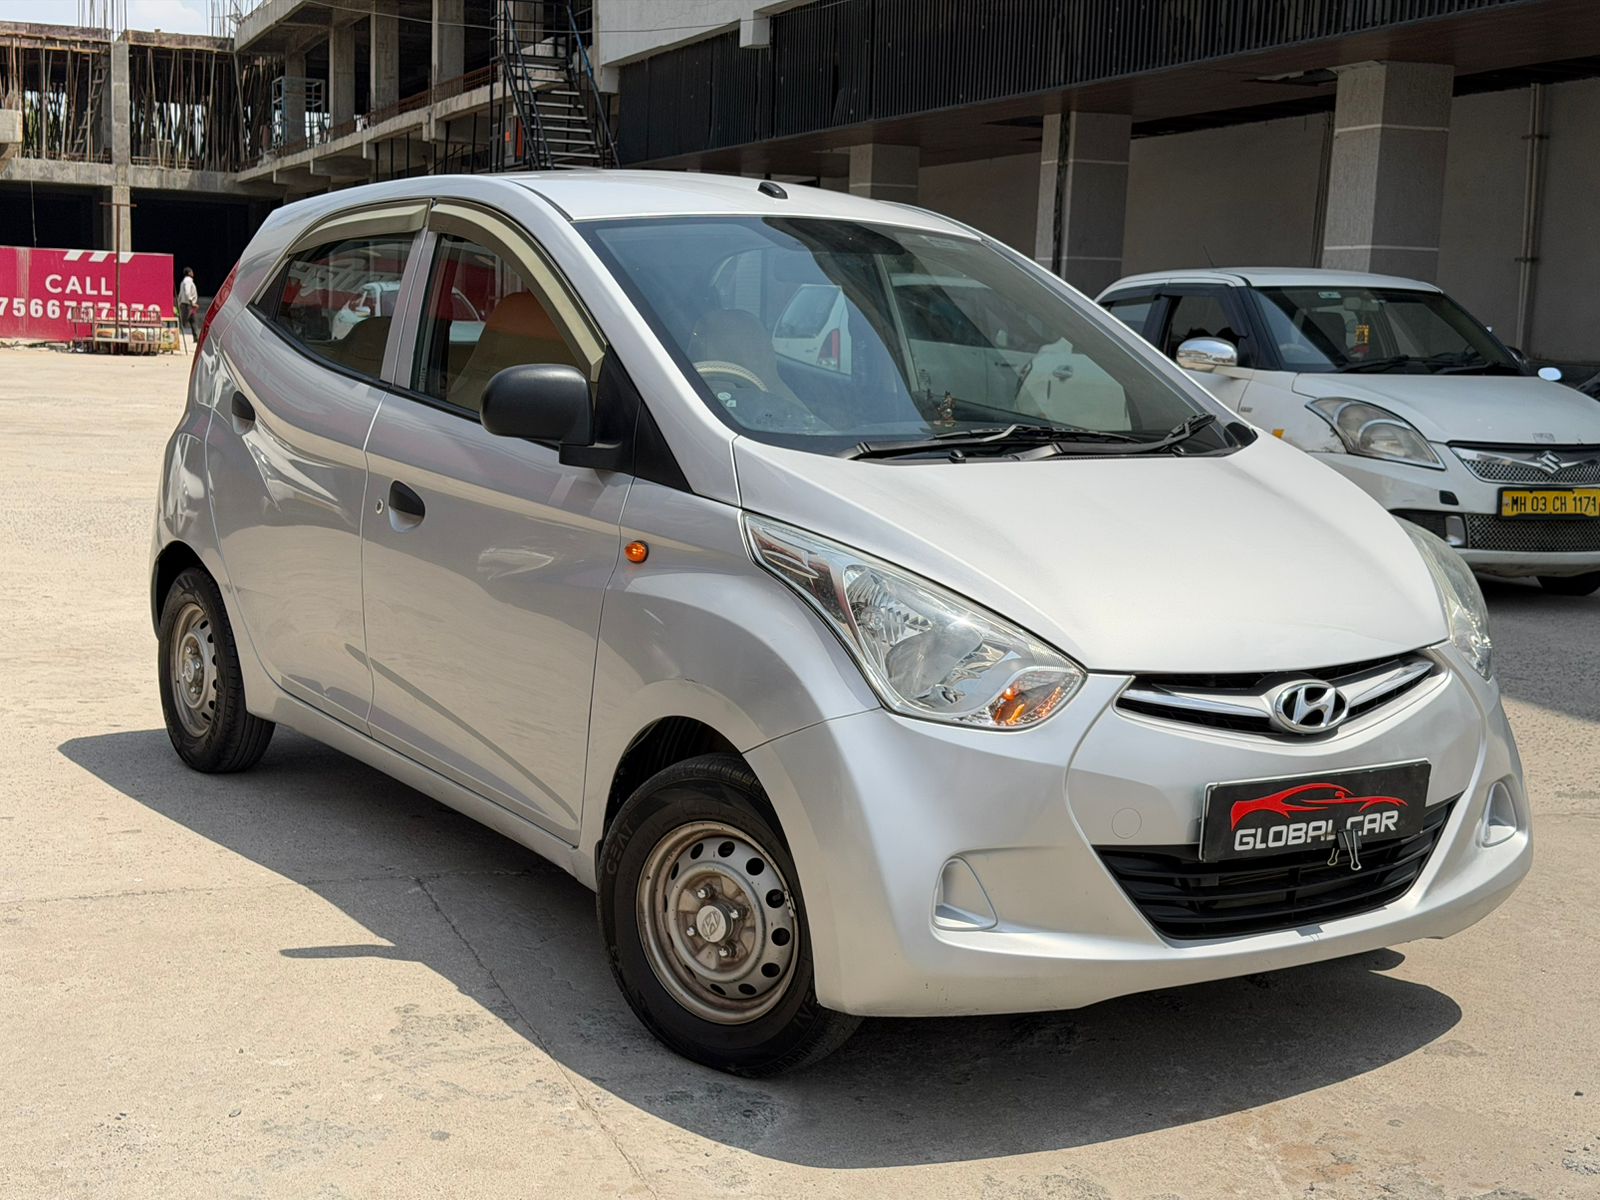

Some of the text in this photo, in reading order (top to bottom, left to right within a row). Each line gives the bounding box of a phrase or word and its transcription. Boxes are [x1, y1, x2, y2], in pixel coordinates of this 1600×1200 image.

[45, 274, 113, 296] CALL
[1511, 496, 1597, 512] MH 03 CH 1171
[1233, 810, 1399, 851] GLOBAL CAR
